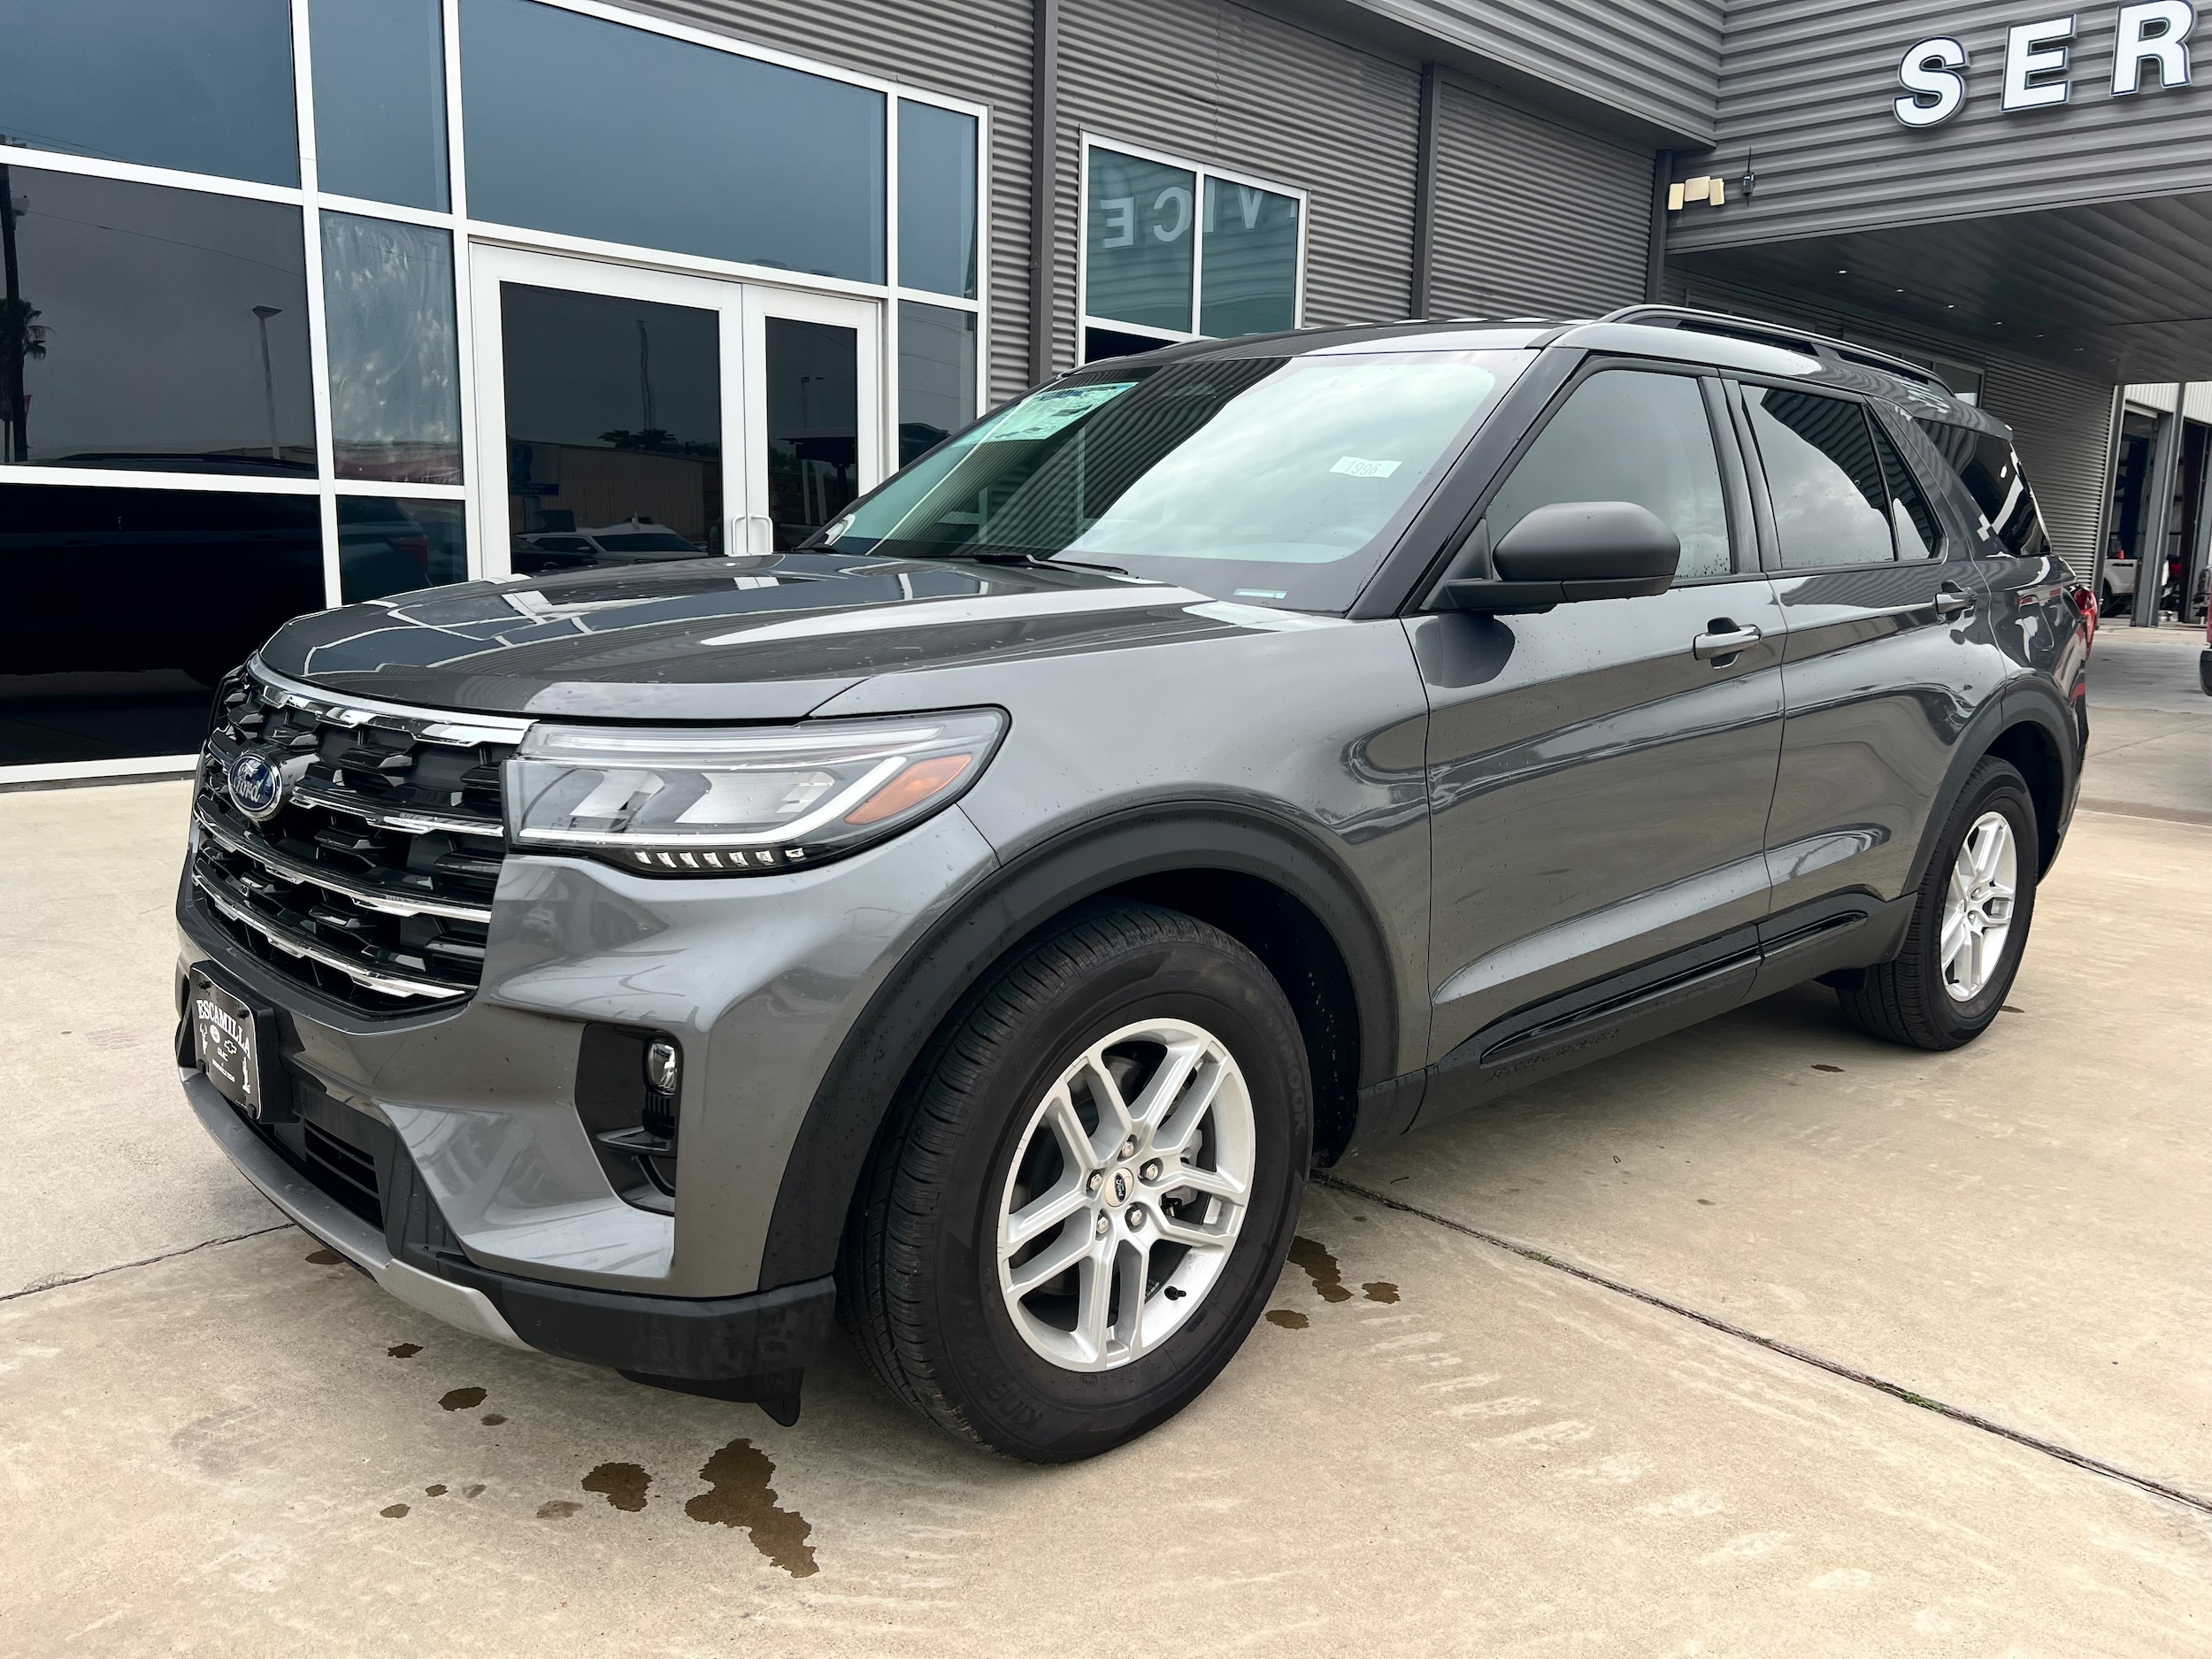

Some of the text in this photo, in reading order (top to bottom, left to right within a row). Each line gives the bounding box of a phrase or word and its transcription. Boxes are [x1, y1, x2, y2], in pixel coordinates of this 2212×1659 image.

[1893, 0, 2198, 127] SER
[1345, 460, 1382, 475] 1996
[234, 762, 265, 803] Ford
[196, 999, 251, 1060] ESCAMILLA
